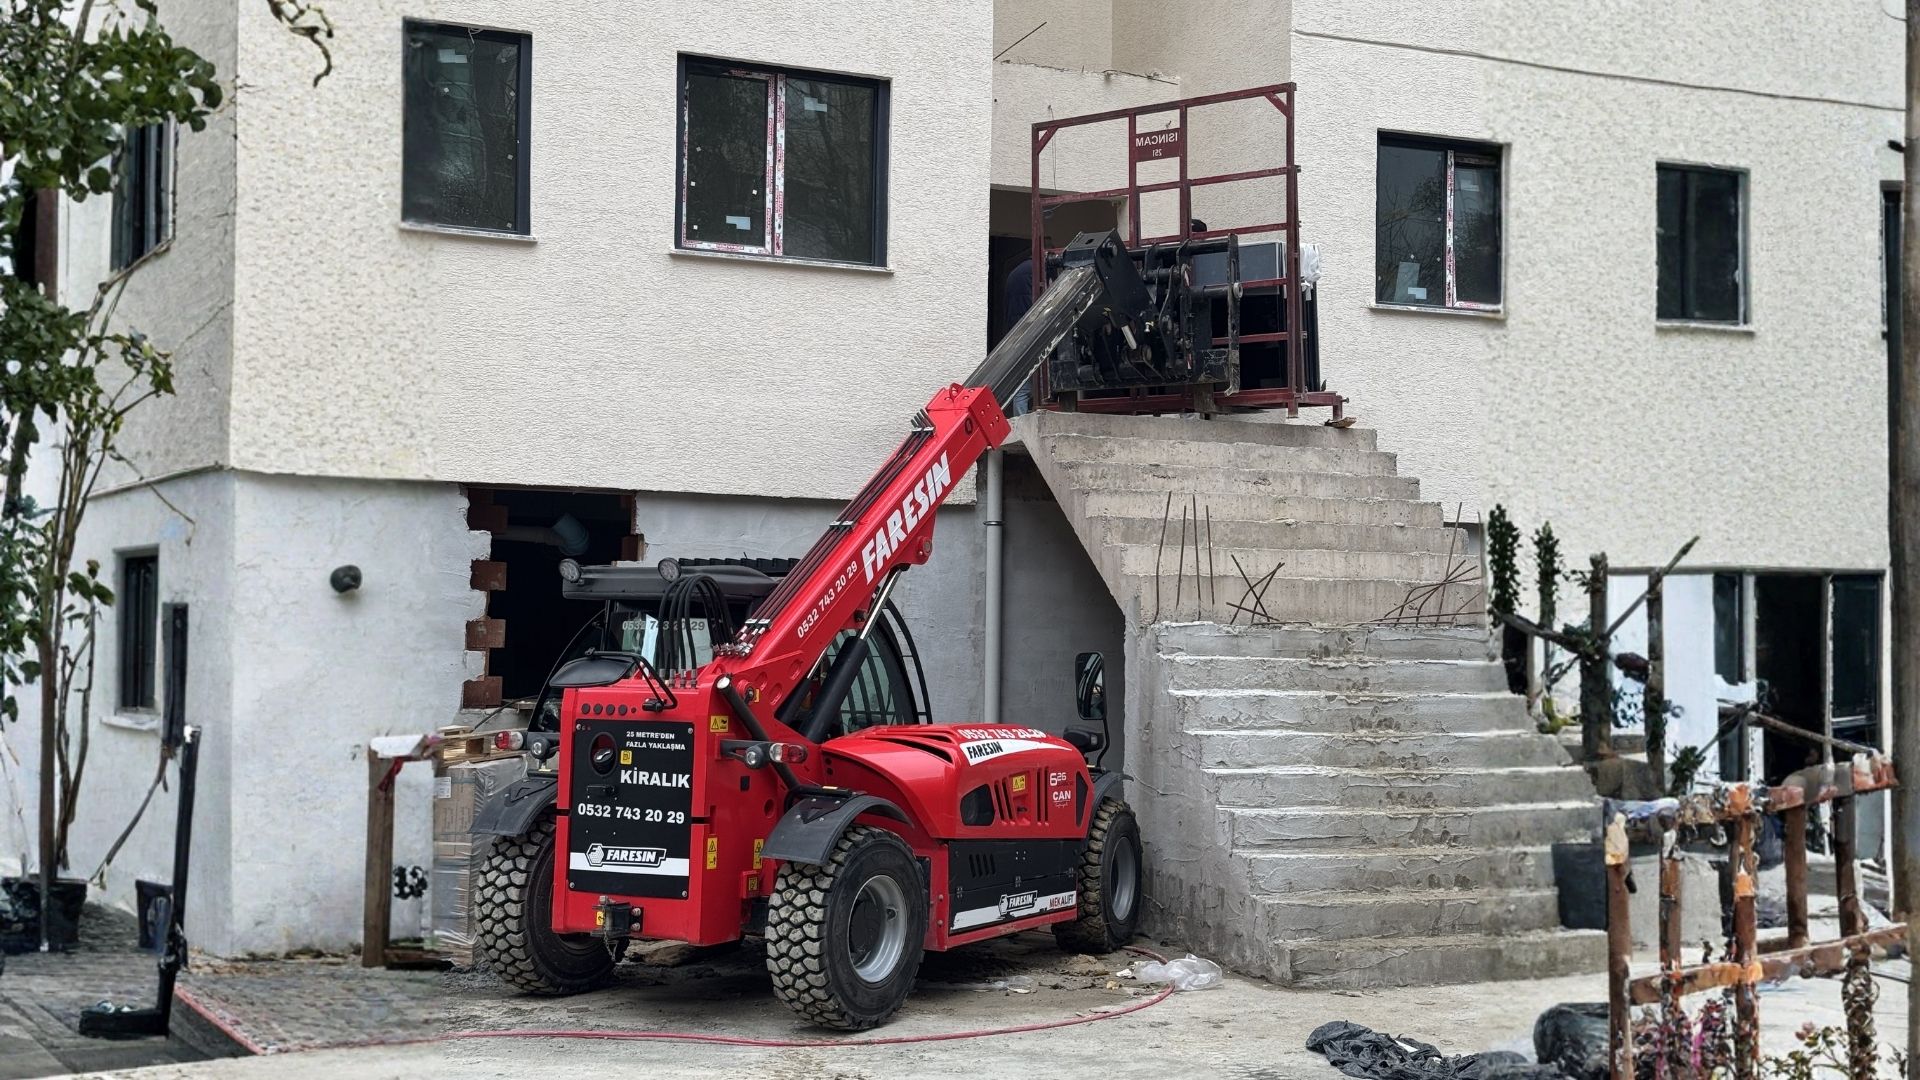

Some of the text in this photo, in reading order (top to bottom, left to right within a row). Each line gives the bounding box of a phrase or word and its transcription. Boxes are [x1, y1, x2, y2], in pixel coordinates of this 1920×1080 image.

[861, 451, 951, 586] FARESIN
[797, 560, 857, 638] 0532 743 20 29
[622, 620, 646, 630] 0532
[650, 620, 669, 630] 73
[690, 620, 705, 631] 29
[635, 731, 675, 739] METRE'DEN
[958, 729, 993, 739] 0532
[987, 729, 1015, 739] 743
[648, 742, 686, 751] YAKLAŞMA
[966, 741, 1004, 759] FARESIN
[620, 766, 691, 788] KİRALIK
[1052, 790, 1071, 801] CAN
[577, 803, 685, 825] 0532 743 20 29
[606, 849, 657, 863] FARESIN
[1009, 894, 1034, 909] FARESIN
[1049, 894, 1074, 907] MEKALIFT
